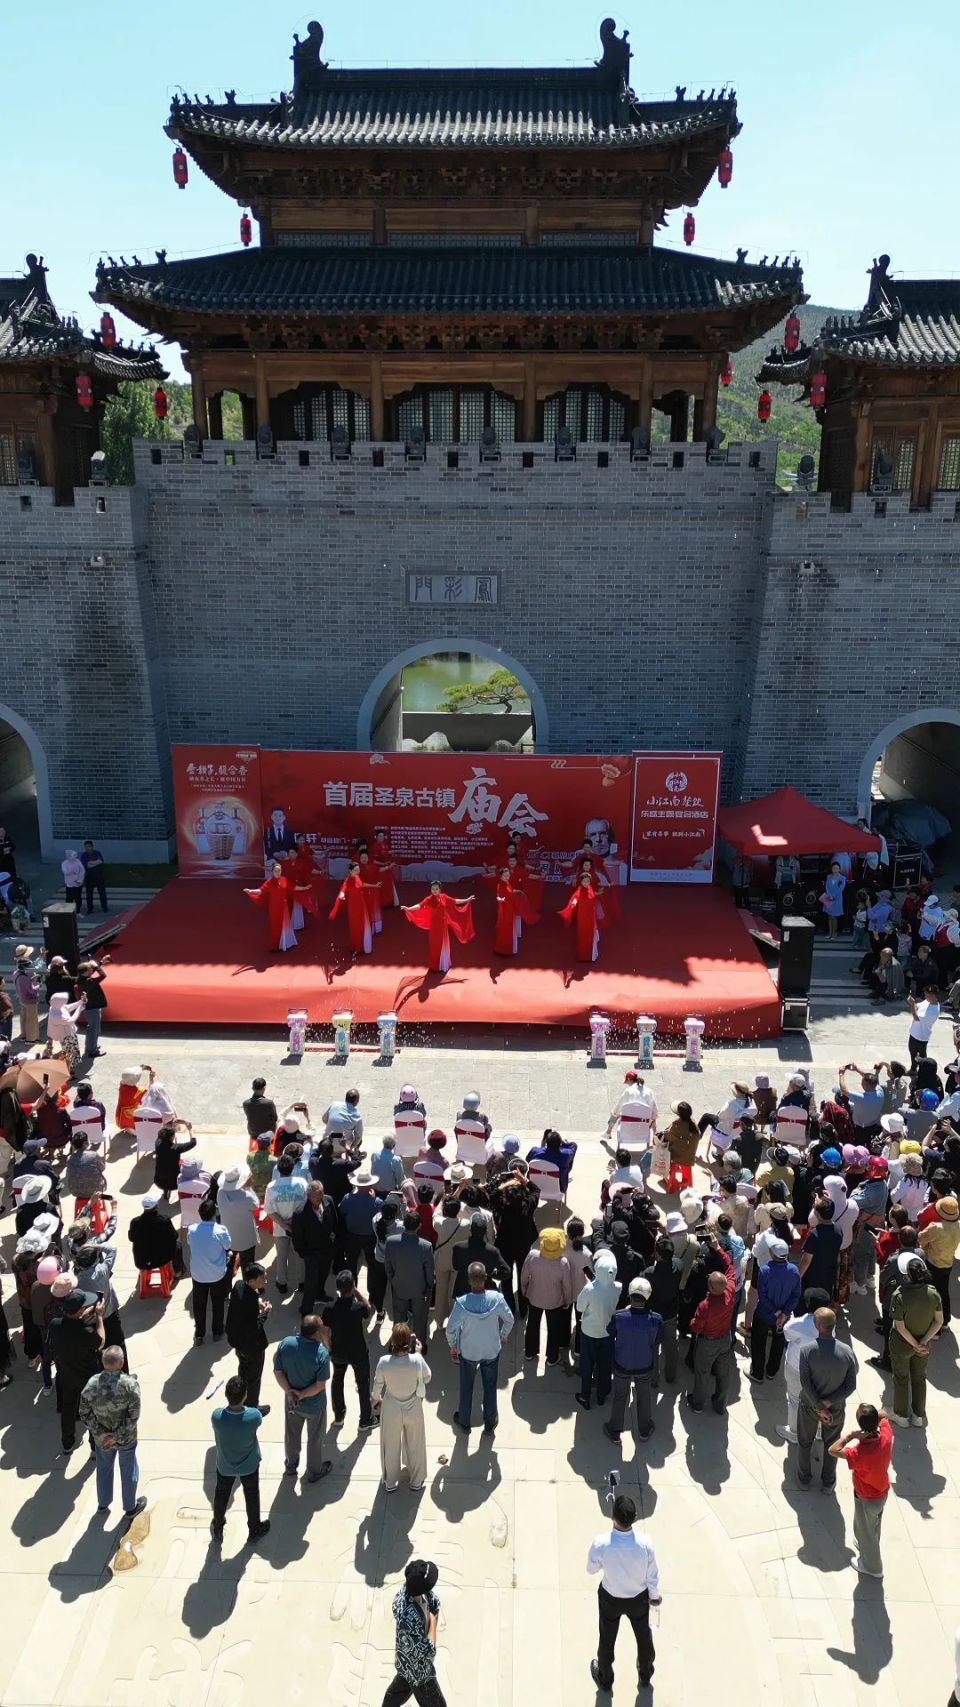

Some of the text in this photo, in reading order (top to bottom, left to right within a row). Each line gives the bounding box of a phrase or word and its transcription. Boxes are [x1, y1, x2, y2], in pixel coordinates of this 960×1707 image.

[323, 767, 549, 837] 首届圣泉古镇 庙会
